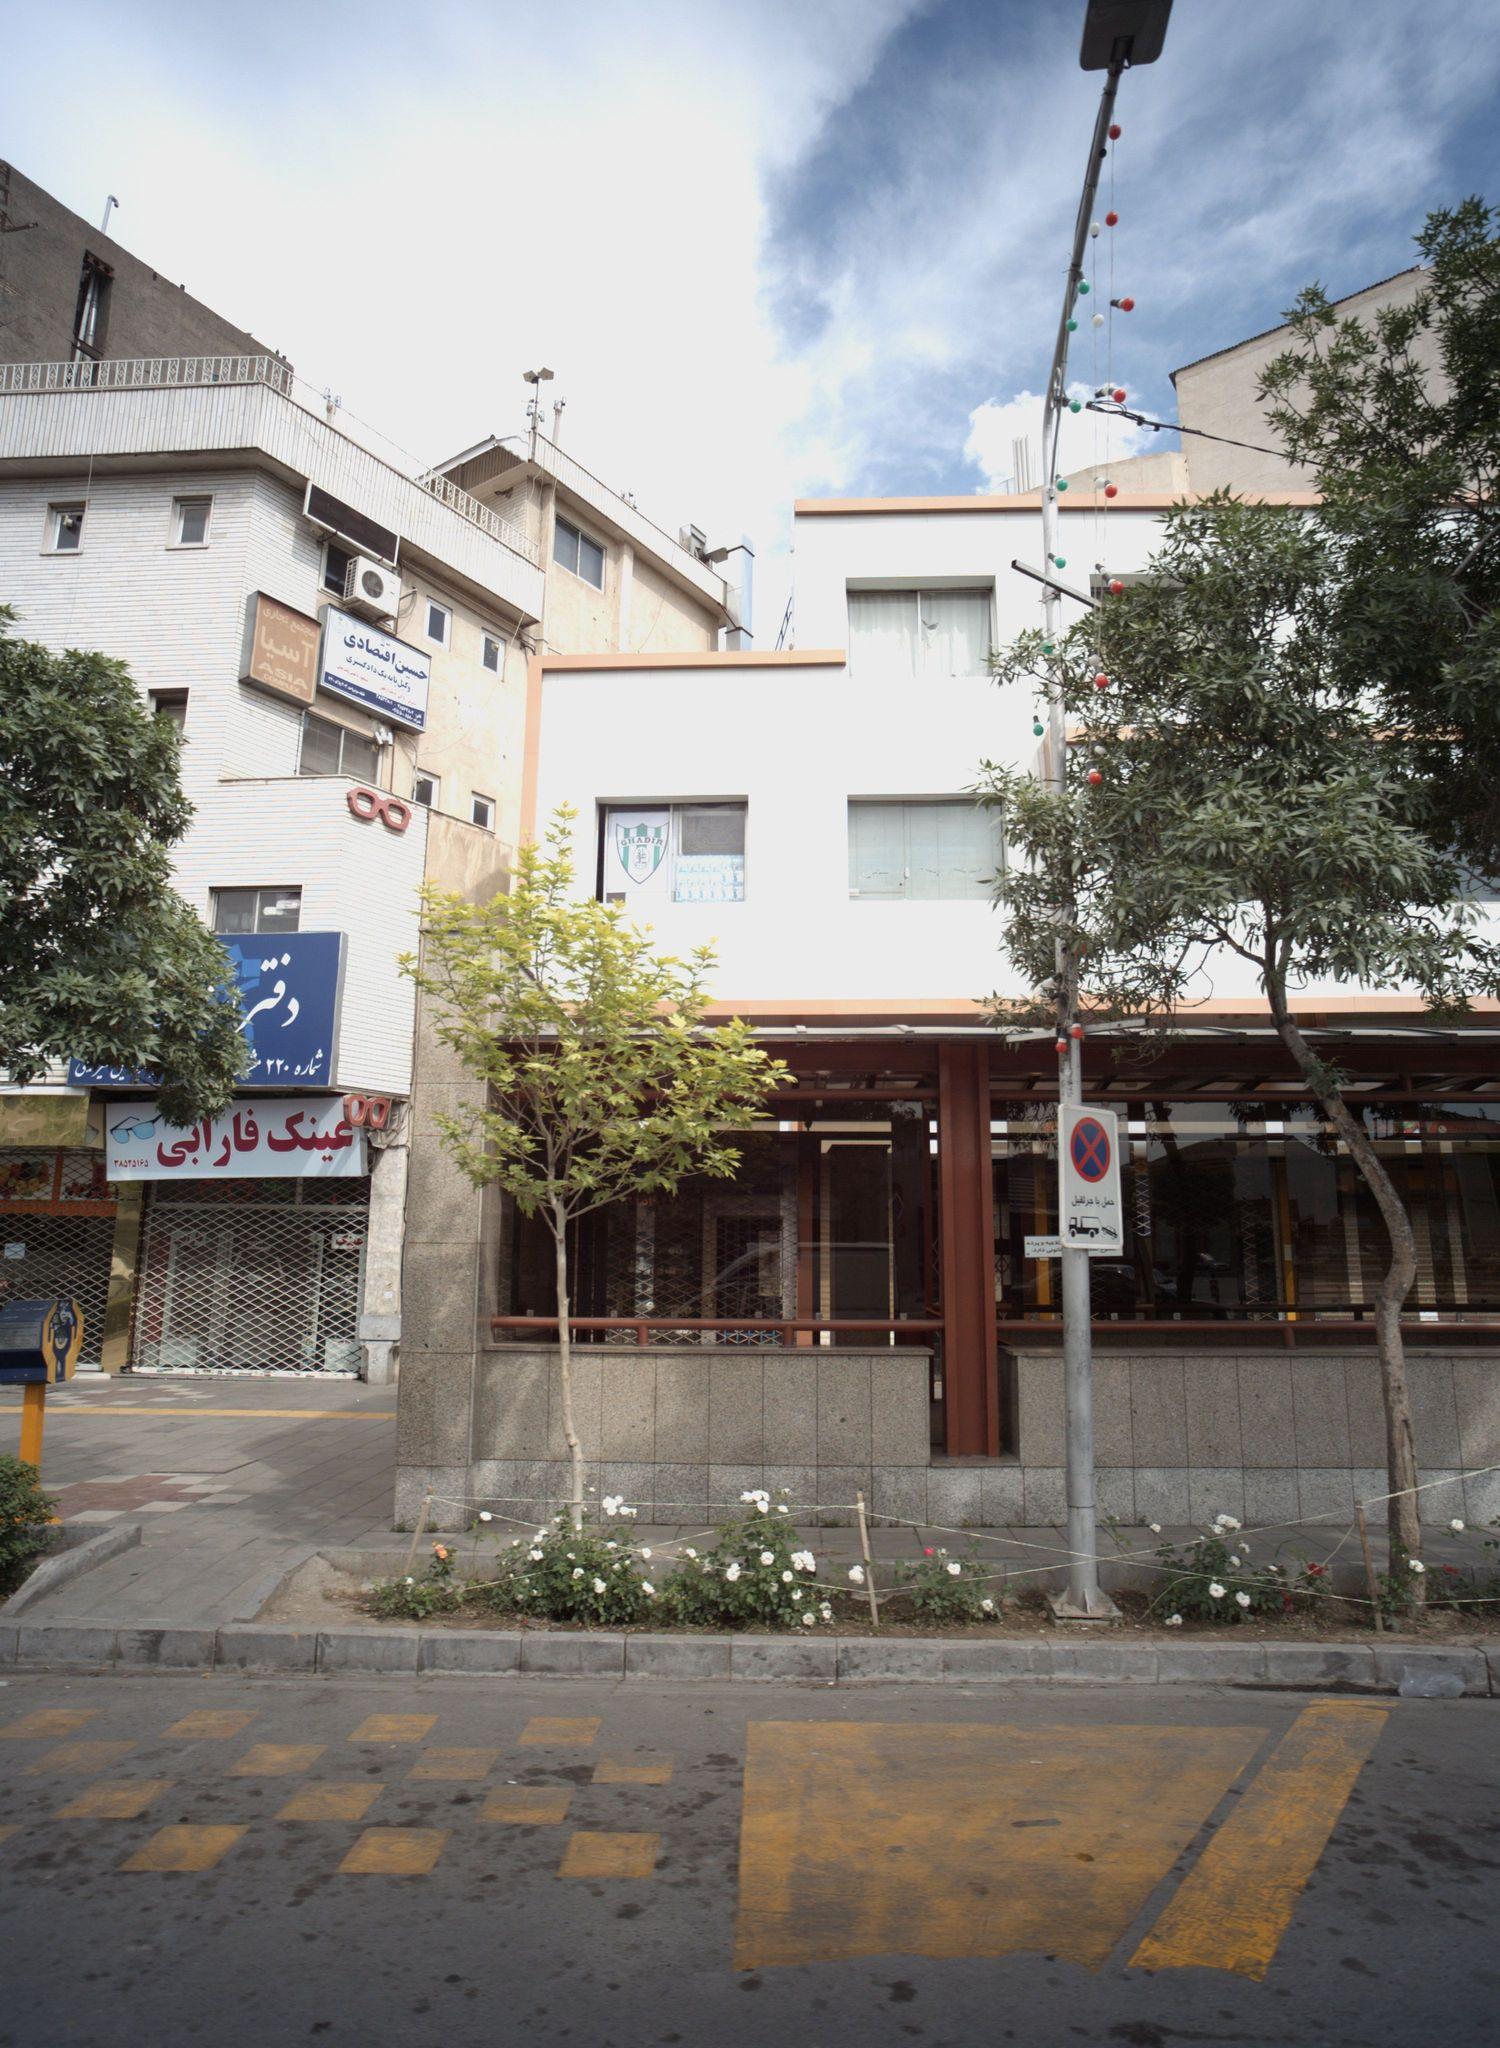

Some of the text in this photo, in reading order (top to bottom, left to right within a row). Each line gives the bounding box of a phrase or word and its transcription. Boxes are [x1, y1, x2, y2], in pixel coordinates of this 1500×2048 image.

[260, 625, 314, 668] آسیا
[343, 634, 396, 665] اقتصادی
[257, 661, 309, 690] ASIA
[394, 660, 428, 680] حسین
[620, 837, 663, 846] GHADIR
[234, 952, 300, 1033] دفتر
[266, 1058, 290, 1076] ۲۲۰
[294, 1049, 322, 1076] شماره
[157, 1108, 353, 1168] عینک فارابی
[1094, 1196, 1100, 1208] با
[1101, 1196, 1115, 1208] حمل
